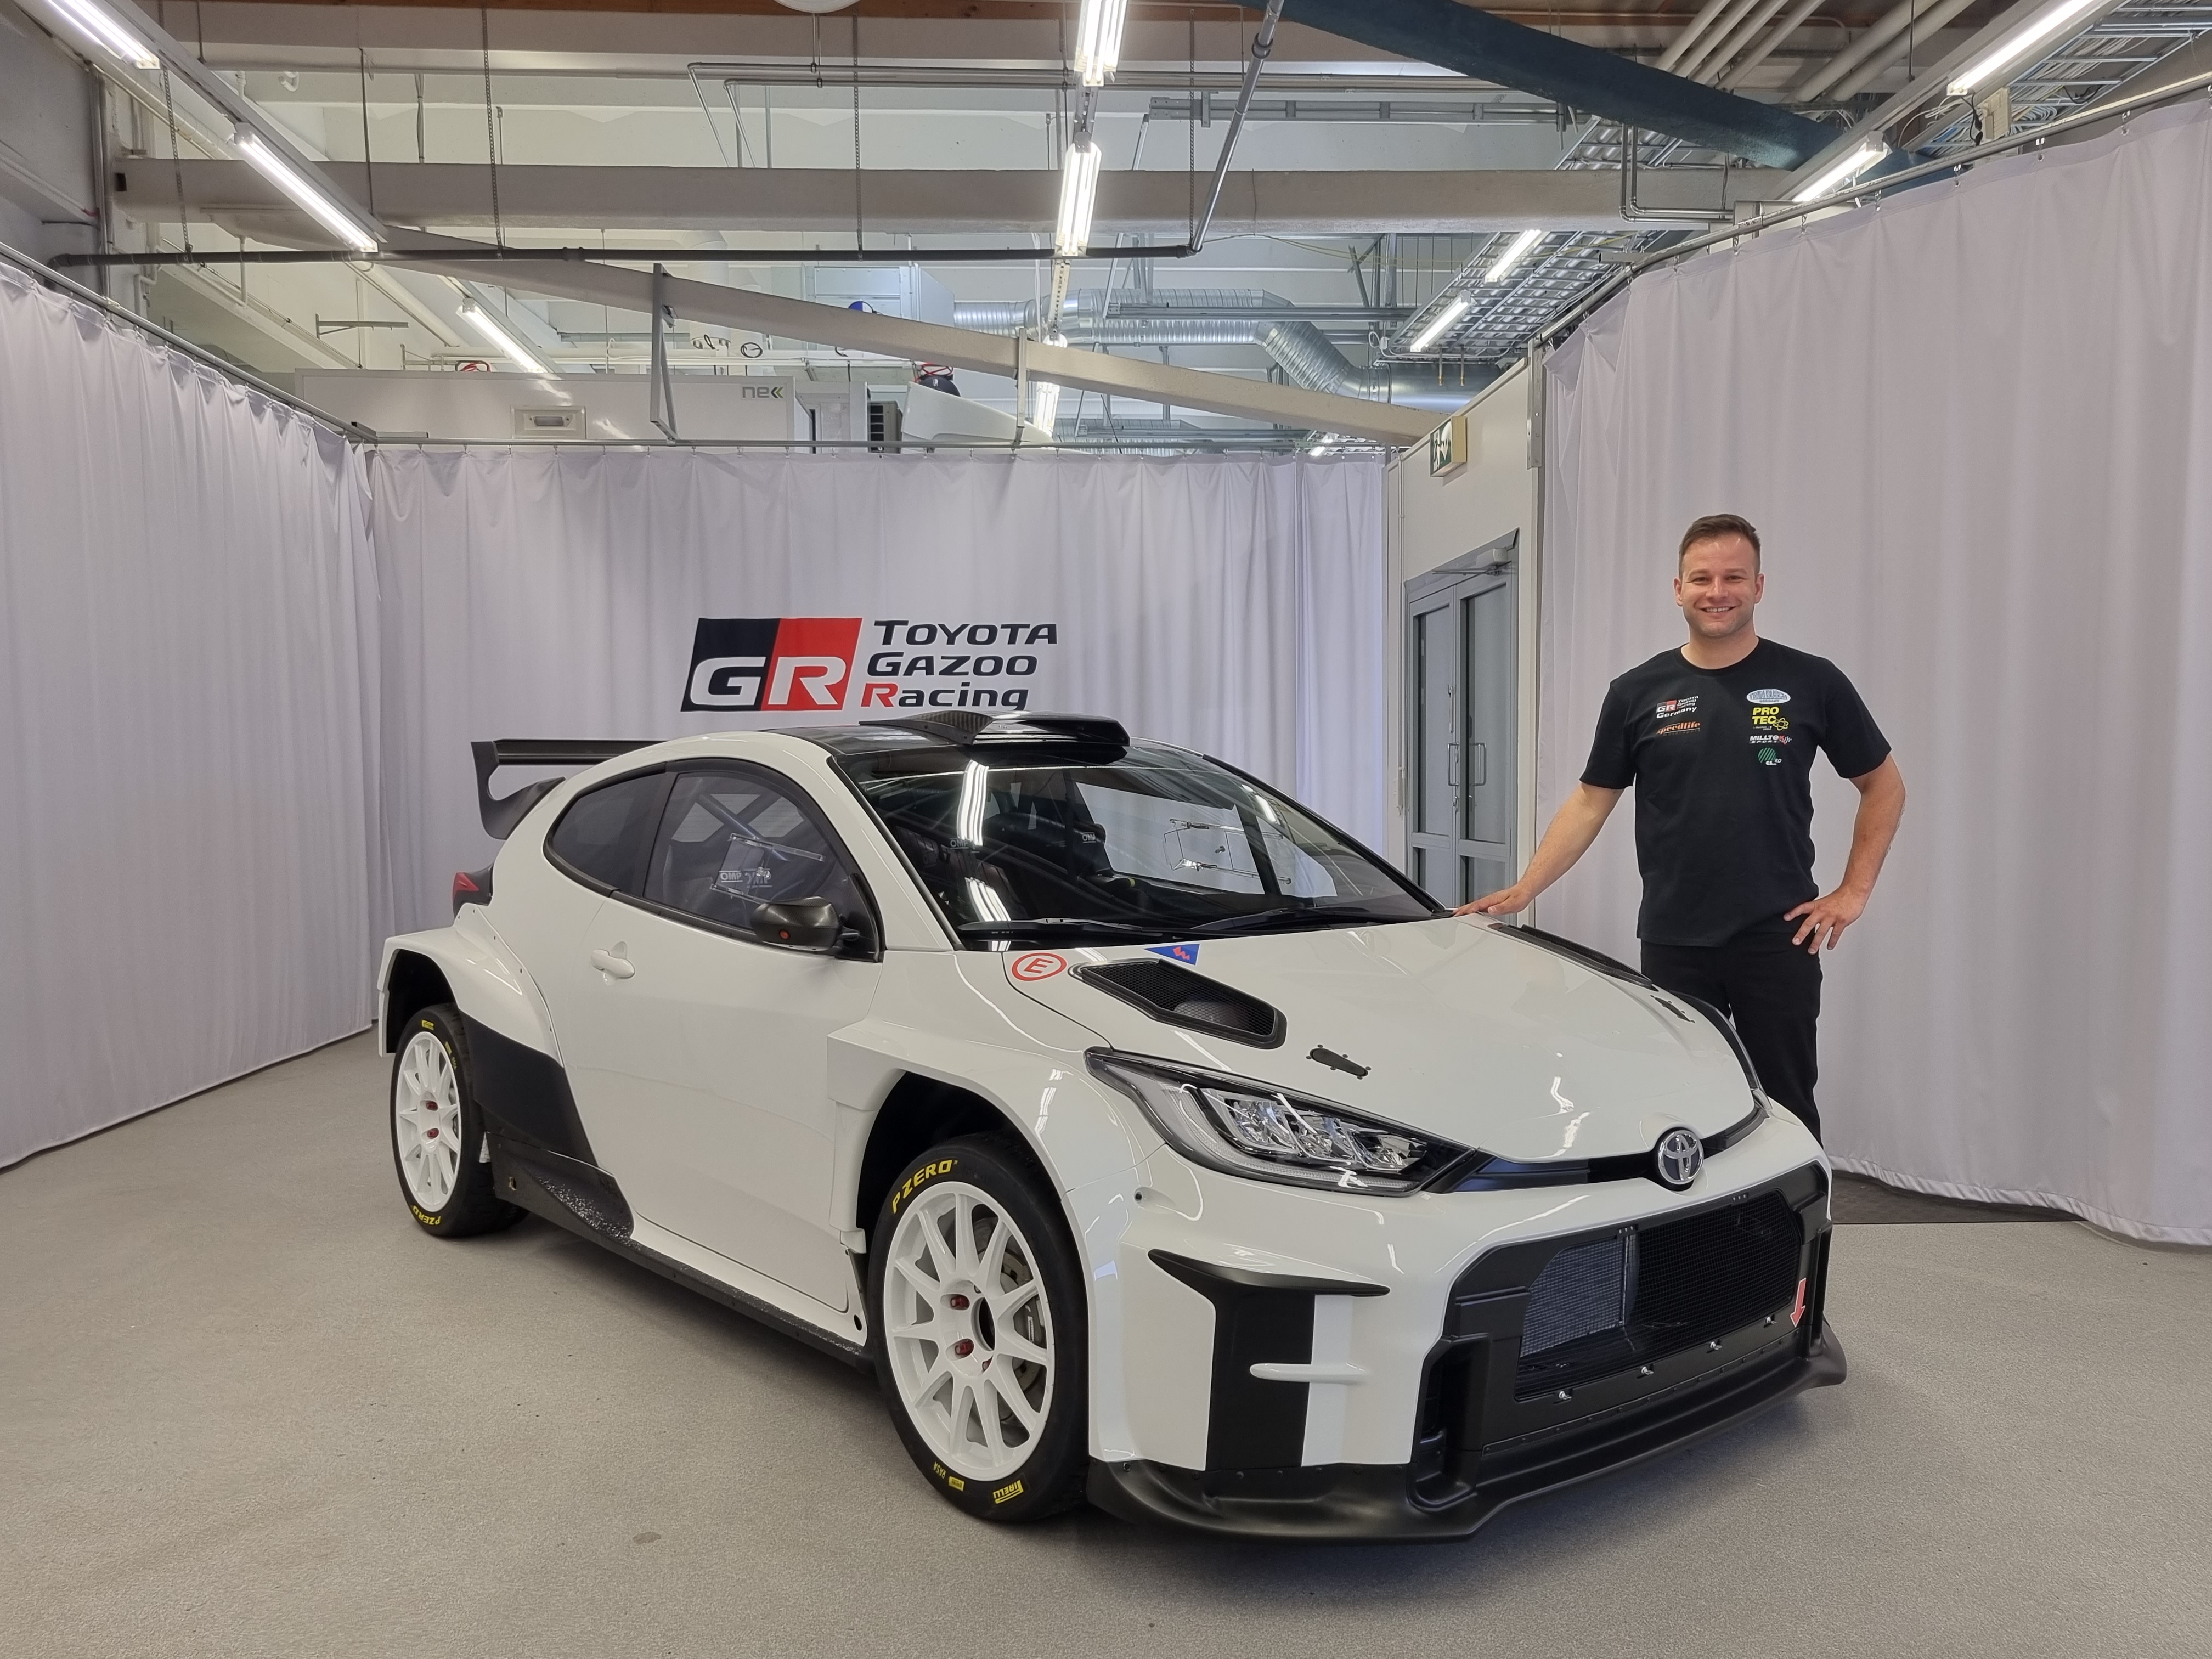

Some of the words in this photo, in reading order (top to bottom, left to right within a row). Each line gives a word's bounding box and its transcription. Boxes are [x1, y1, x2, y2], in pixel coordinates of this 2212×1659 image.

[874, 620, 1057, 646] TOYOTA
[867, 652, 1037, 676] GAZOO
[690, 656, 847, 706] GR
[861, 682, 1029, 711] Racing
[1656, 706, 1697, 719] Germany
[1657, 704, 1675, 713] GR
[1752, 706, 1780, 715] PRO
[1752, 715, 1777, 725] TEC
[720, 872, 742, 881] OMP
[1023, 958, 1054, 974] E
[992, 1479, 1024, 1504] PIRELLI
